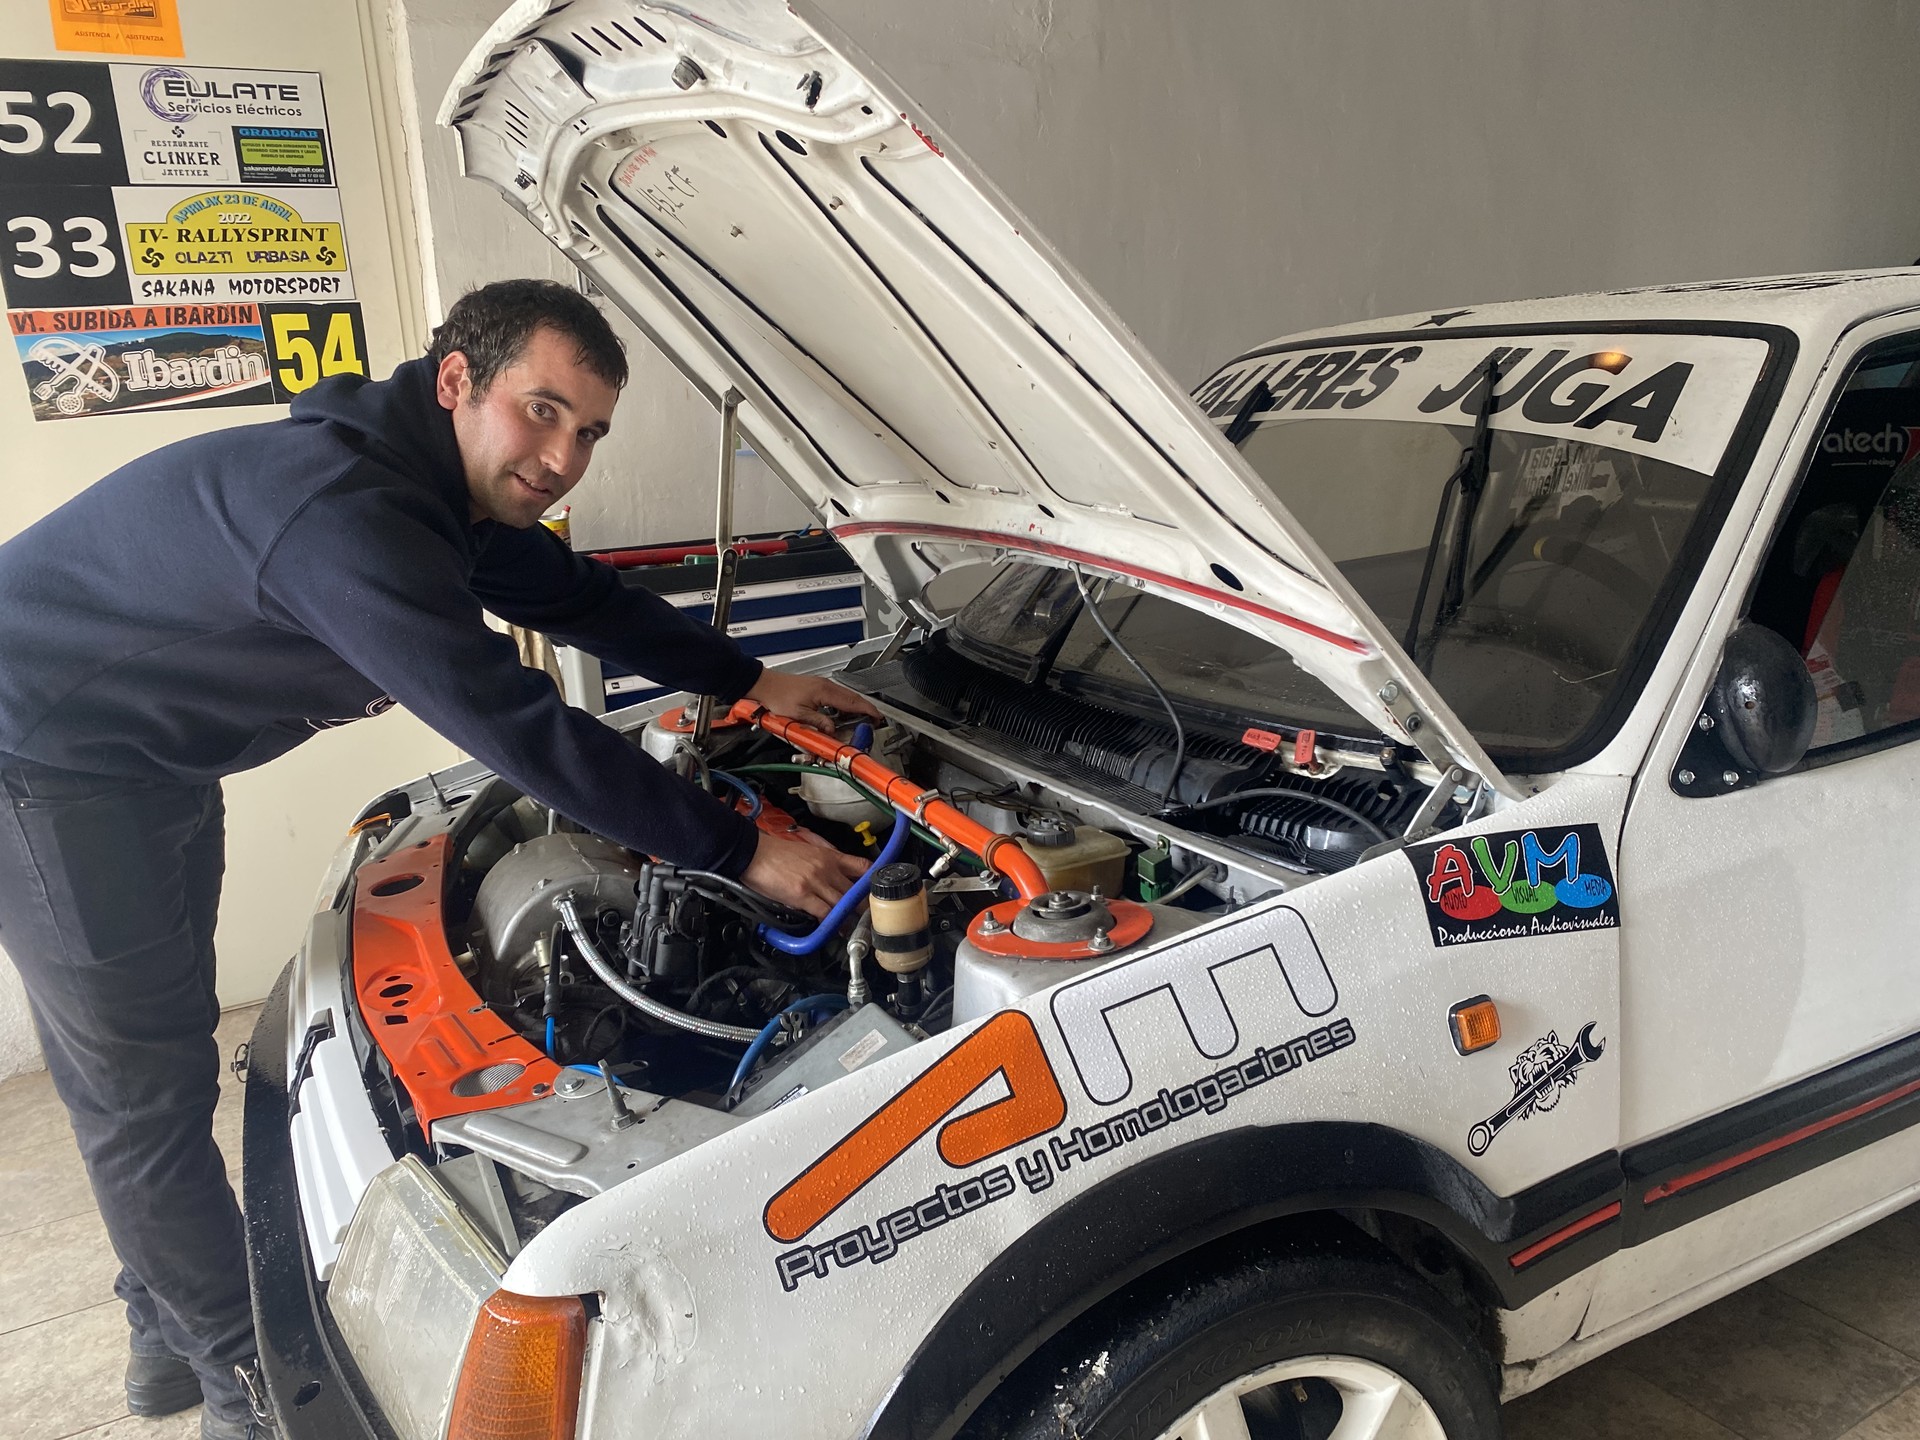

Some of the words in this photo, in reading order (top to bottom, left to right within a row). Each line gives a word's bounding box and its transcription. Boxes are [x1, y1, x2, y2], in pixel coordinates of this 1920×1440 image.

[163, 79, 300, 101] EULATE
[0, 91, 101, 153] 52
[168, 102, 231, 114] Servicios
[236, 103, 302, 116] Eléctricos
[151, 140, 208, 148] RESTAURANTE
[239, 127, 319, 138] GRABOLAB
[143, 151, 221, 165] CLINKER
[161, 168, 209, 176] JATETXEA
[218, 213, 252, 224] 2022
[224, 194, 240, 205] 23
[242, 196, 259, 206] DE
[260, 200, 293, 222] ABRIL
[7, 216, 116, 278] 33
[139, 228, 169, 243] IV-
[177, 227, 329, 243] RALLYSPRINT
[175, 250, 233, 264] OLAZTI
[246, 250, 311, 264] URBASA
[141, 278, 216, 298] SAKANA
[228, 276, 341, 296] MOTORSPORT
[13, 313, 45, 334] VI.
[53, 309, 137, 332] SUBIDA
[144, 308, 158, 327] A
[165, 305, 253, 326] IBARDIN
[270, 313, 364, 394] 54
[122, 345, 268, 392] Ibardin
[1196, 346, 1423, 418] TALLERES
[1417, 346, 1694, 443] JUGA
[1427, 831, 1580, 902] AVM
[1443, 895, 1468, 911] AUDIO
[1511, 884, 1538, 903] VISUAL
[1437, 926, 1527, 945] Producciones
[1531, 911, 1615, 935] Audiovisuales
[775, 1164, 1015, 1292] Proyectos
[1015, 1146, 1054, 1194] y
[1049, 1018, 1356, 1171] Homologaciones
